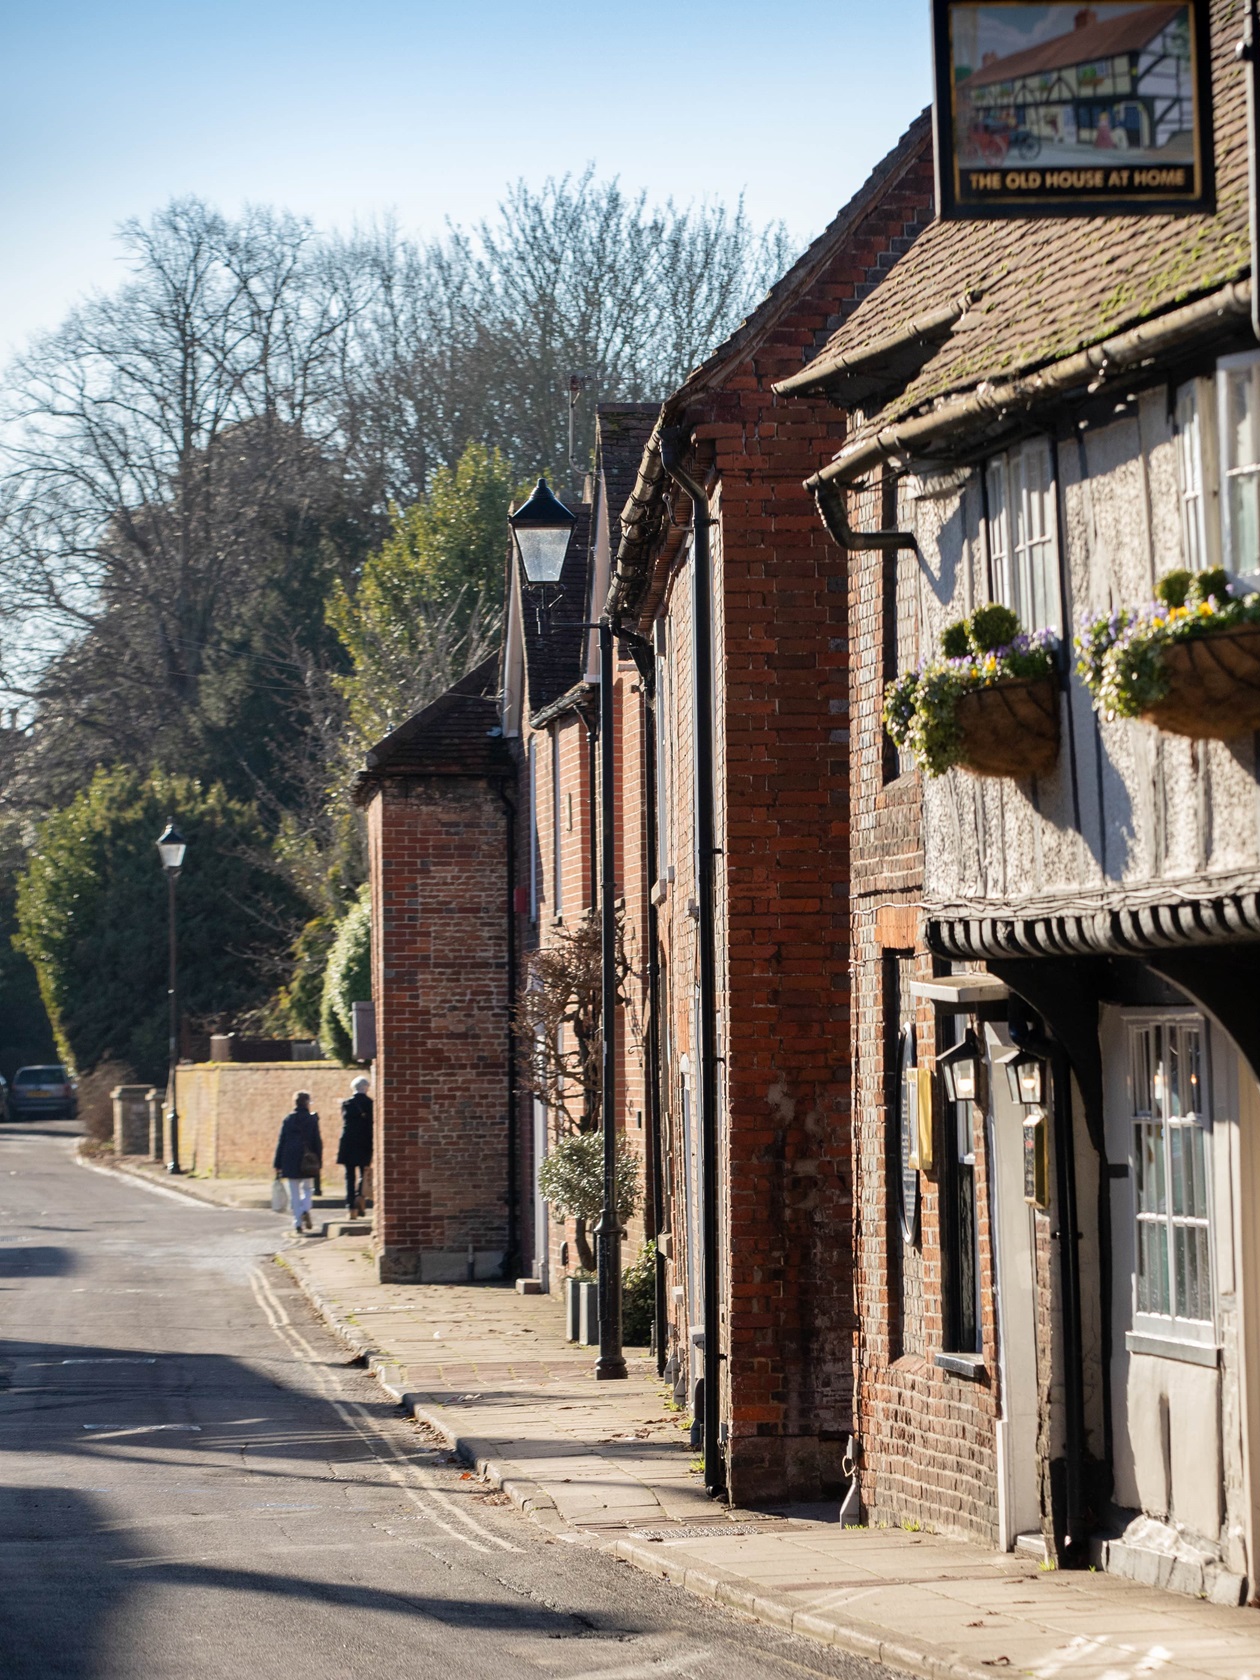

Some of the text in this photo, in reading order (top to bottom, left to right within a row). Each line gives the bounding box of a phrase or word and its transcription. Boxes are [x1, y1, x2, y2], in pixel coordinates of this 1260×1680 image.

[969, 168, 1185, 190] THE OLD HOUSE AT HOME
